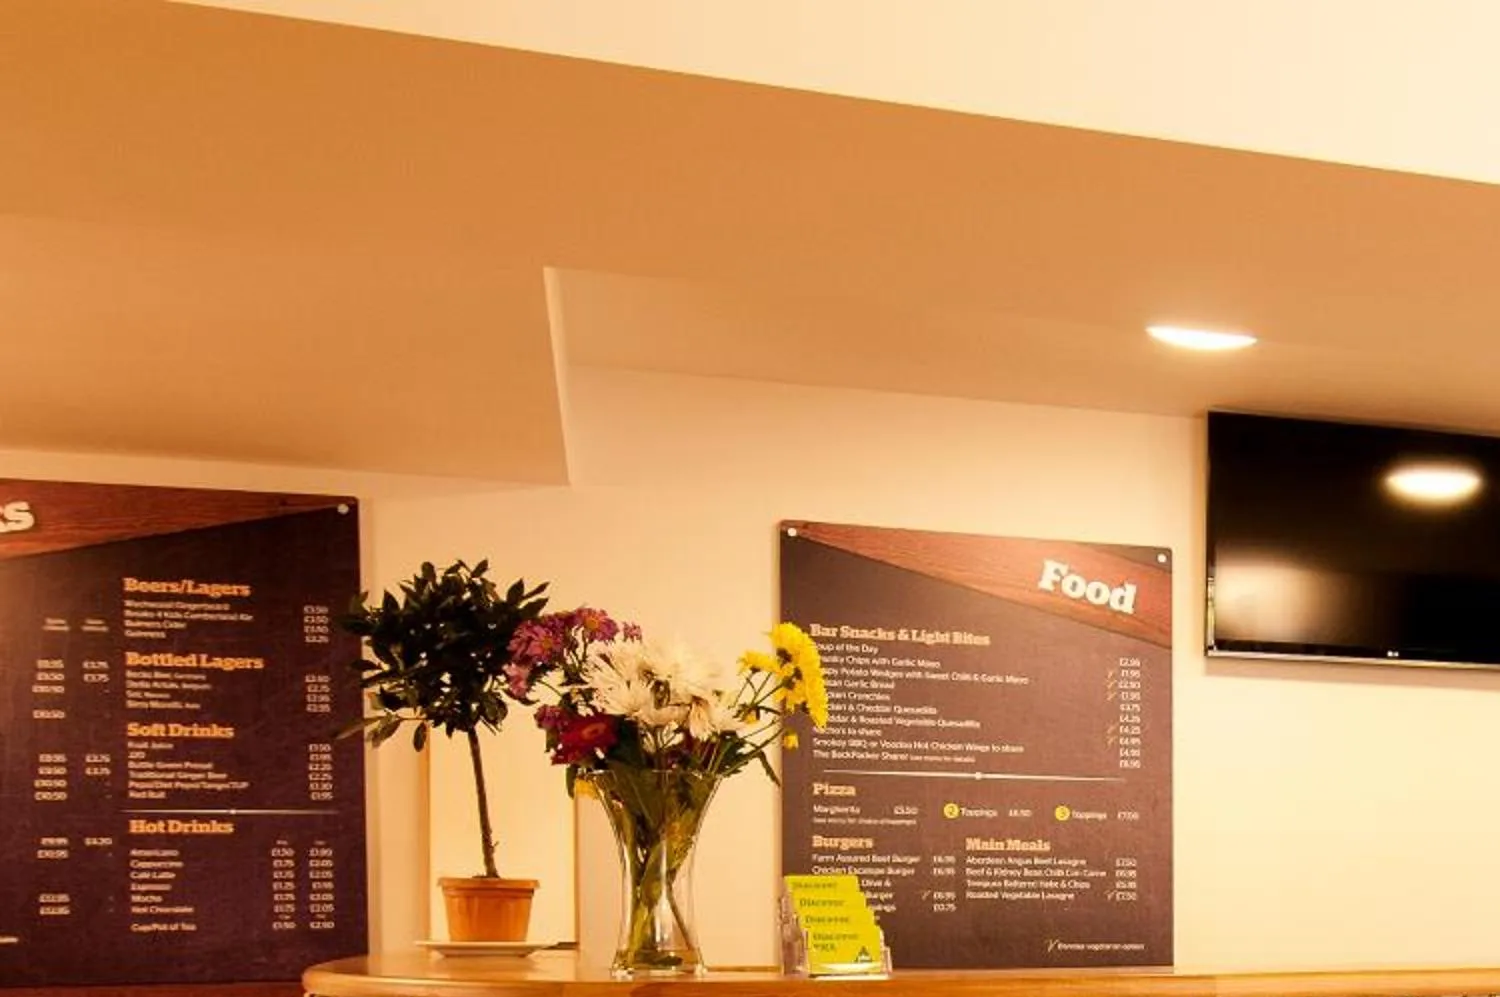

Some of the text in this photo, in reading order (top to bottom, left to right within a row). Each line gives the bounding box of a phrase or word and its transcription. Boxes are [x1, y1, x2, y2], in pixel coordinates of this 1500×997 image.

[124, 577, 251, 598] Beers/Lagers
[1037, 558, 1137, 616] Food
[810, 623, 991, 646] Bar Snacks & Light Bites
[817, 643, 834, 652] oup
[862, 644, 879, 654] Day
[126, 652, 265, 672] Bottled Lagers
[127, 722, 236, 739] Soft Drinks
[812, 781, 857, 798] Pizza
[129, 819, 236, 835] Hot Drinks
[812, 835, 874, 850] Burgers
[965, 837, 1051, 853] Main Meals
